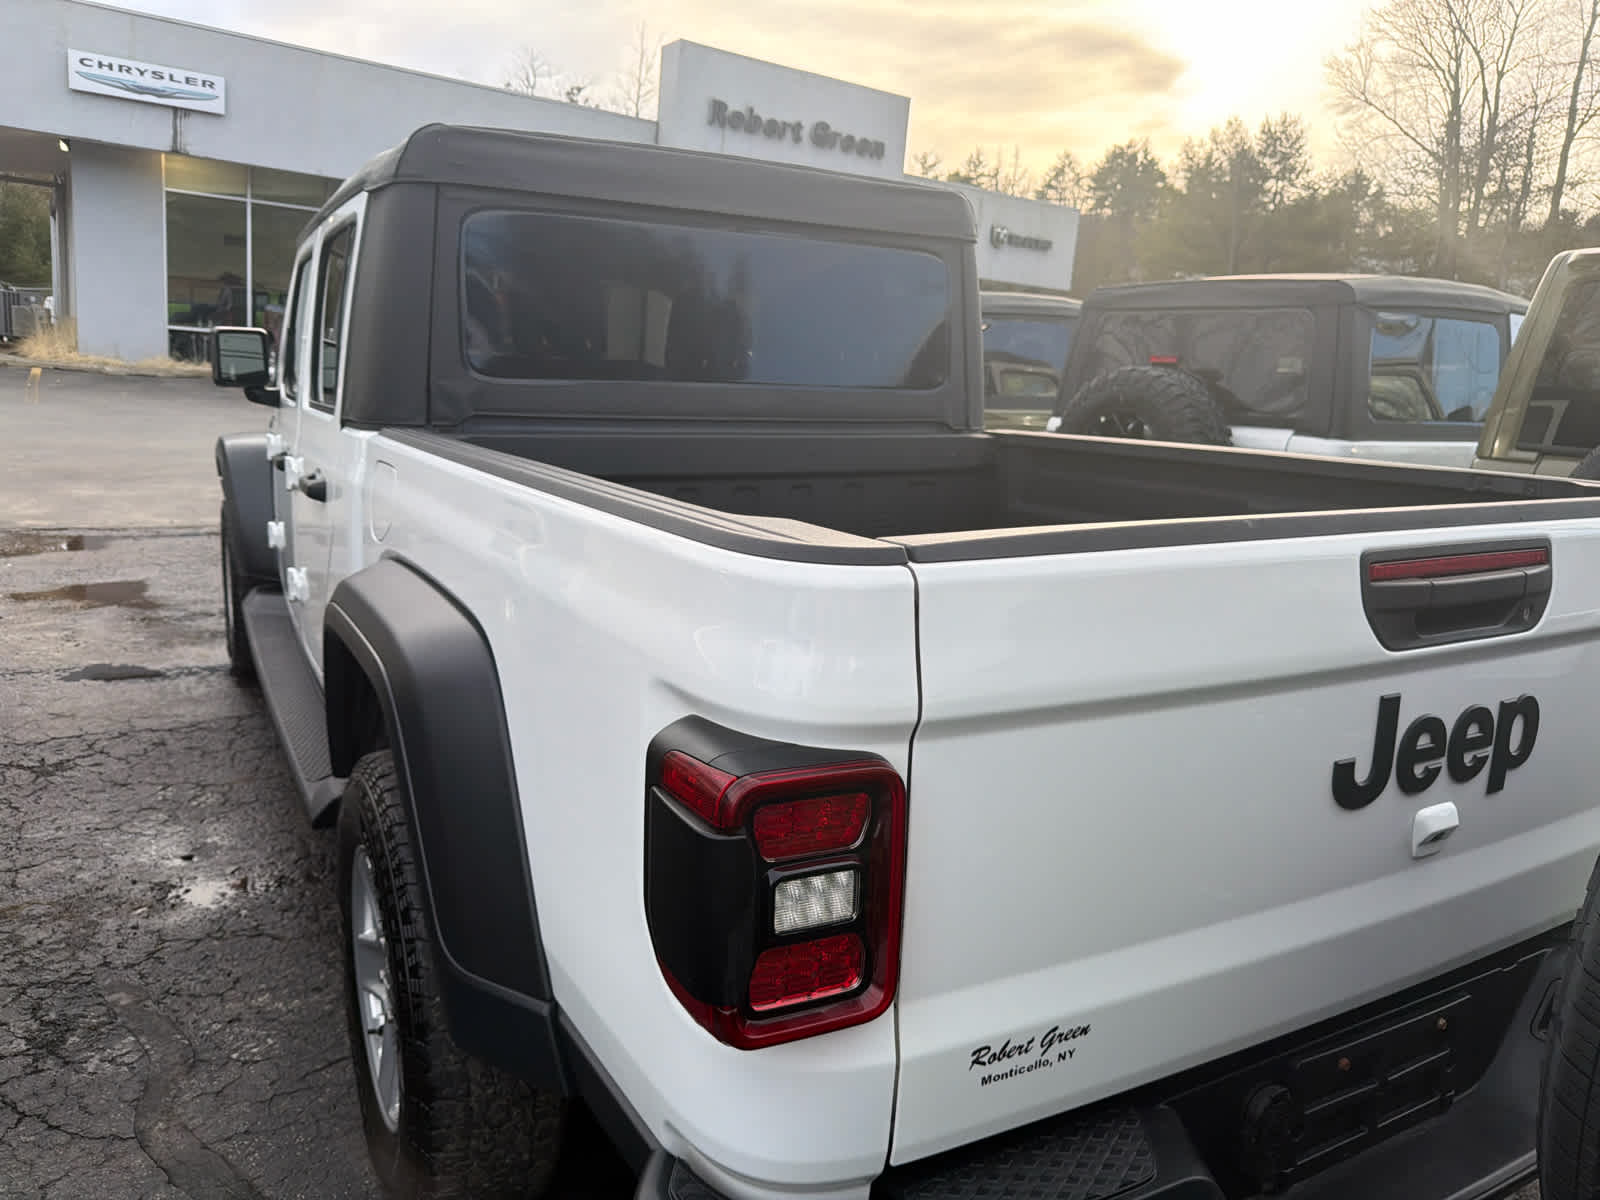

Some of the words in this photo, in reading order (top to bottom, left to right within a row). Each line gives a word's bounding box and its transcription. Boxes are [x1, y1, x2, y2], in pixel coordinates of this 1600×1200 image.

[79, 57, 217, 89] CHRYSLER
[707, 98, 803, 144] Robert
[809, 121, 885, 160] Green
[1331, 692, 1540, 811] Jeep
[969, 1037, 1035, 1072] Robert
[1040, 1024, 1091, 1057] Green
[981, 1058, 1053, 1087] Monticello,
[1057, 1048, 1077, 1063] NY
